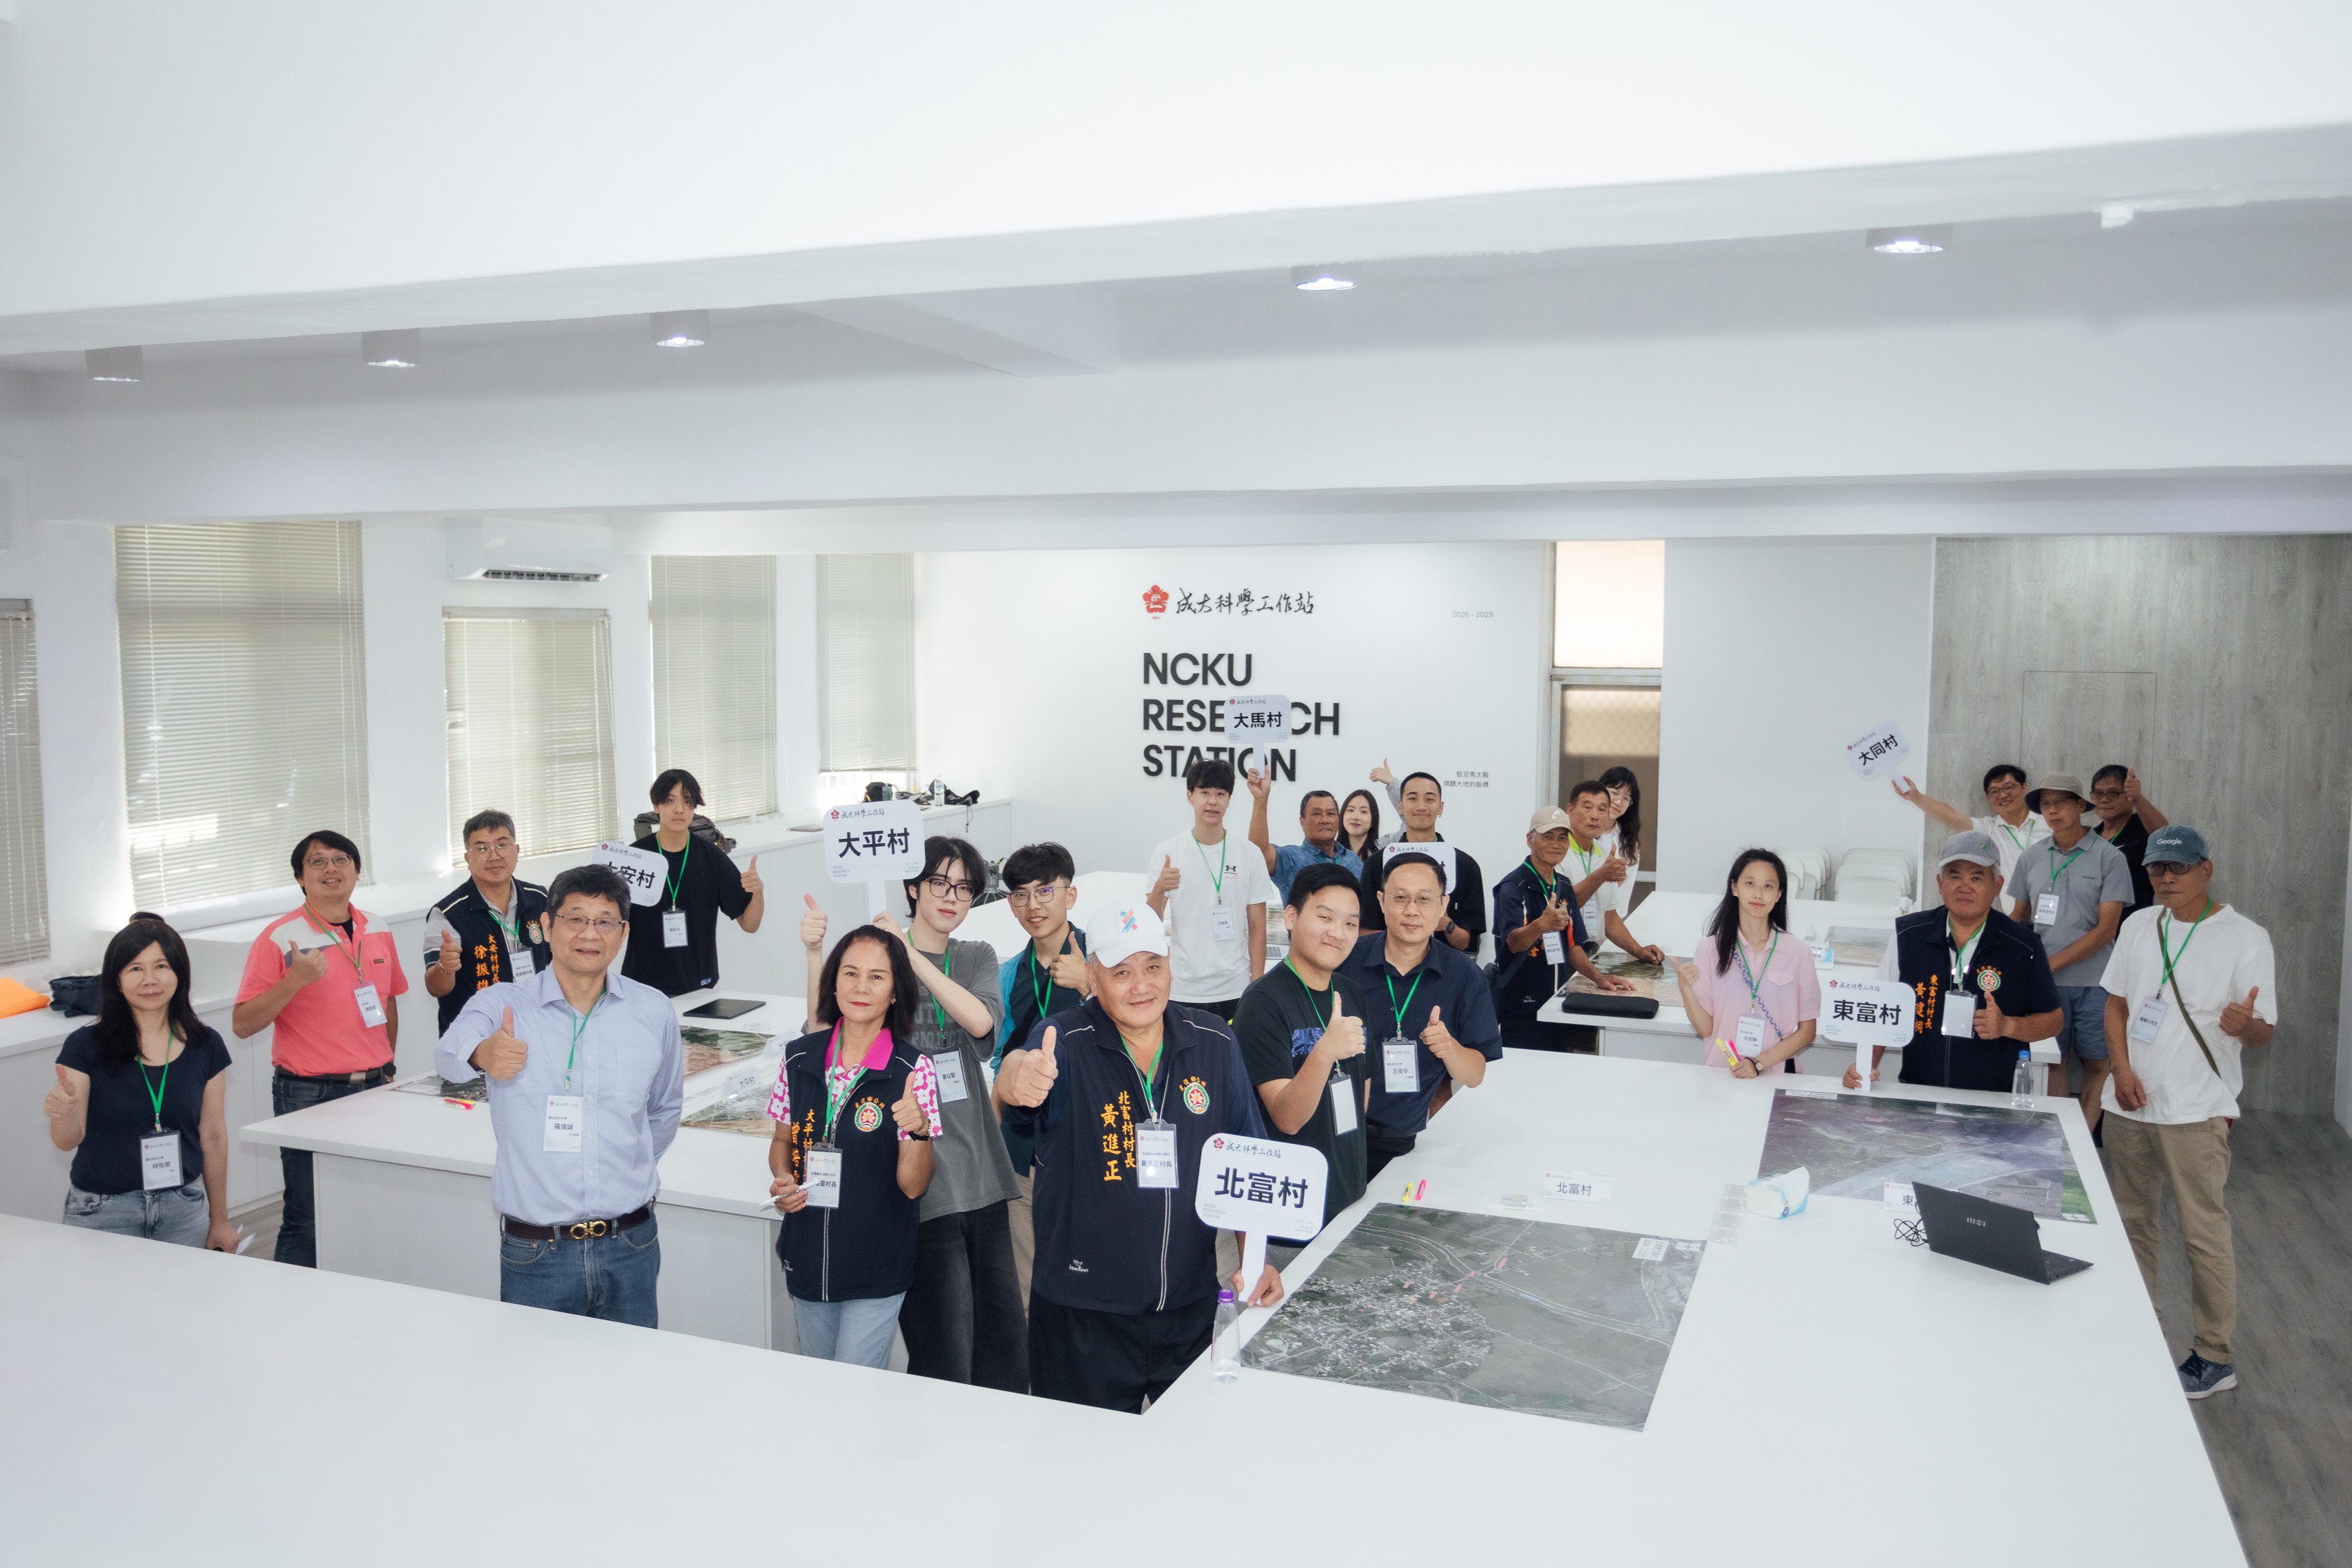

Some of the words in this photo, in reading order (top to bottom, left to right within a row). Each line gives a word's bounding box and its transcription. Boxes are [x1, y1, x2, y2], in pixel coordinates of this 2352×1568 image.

[1176, 587, 1314, 616] 成大科學工作站
[1143, 652, 1252, 686] NCKU
[1143, 699, 1340, 736] RESECH
[1234, 711, 1282, 728] 大馬村
[1858, 734, 1898, 765] 大同村
[839, 828, 909, 858] 大平村
[1832, 1000, 1901, 1025] 東富村
[1101, 1103, 1122, 1181] 黃進正
[1118, 1091, 1136, 1168] 北富村村長
[1226, 1140, 1281, 1158] 成大科學工作站
[1214, 1167, 1308, 1208] 北富村
[1556, 1182, 1591, 1195] 北富村
